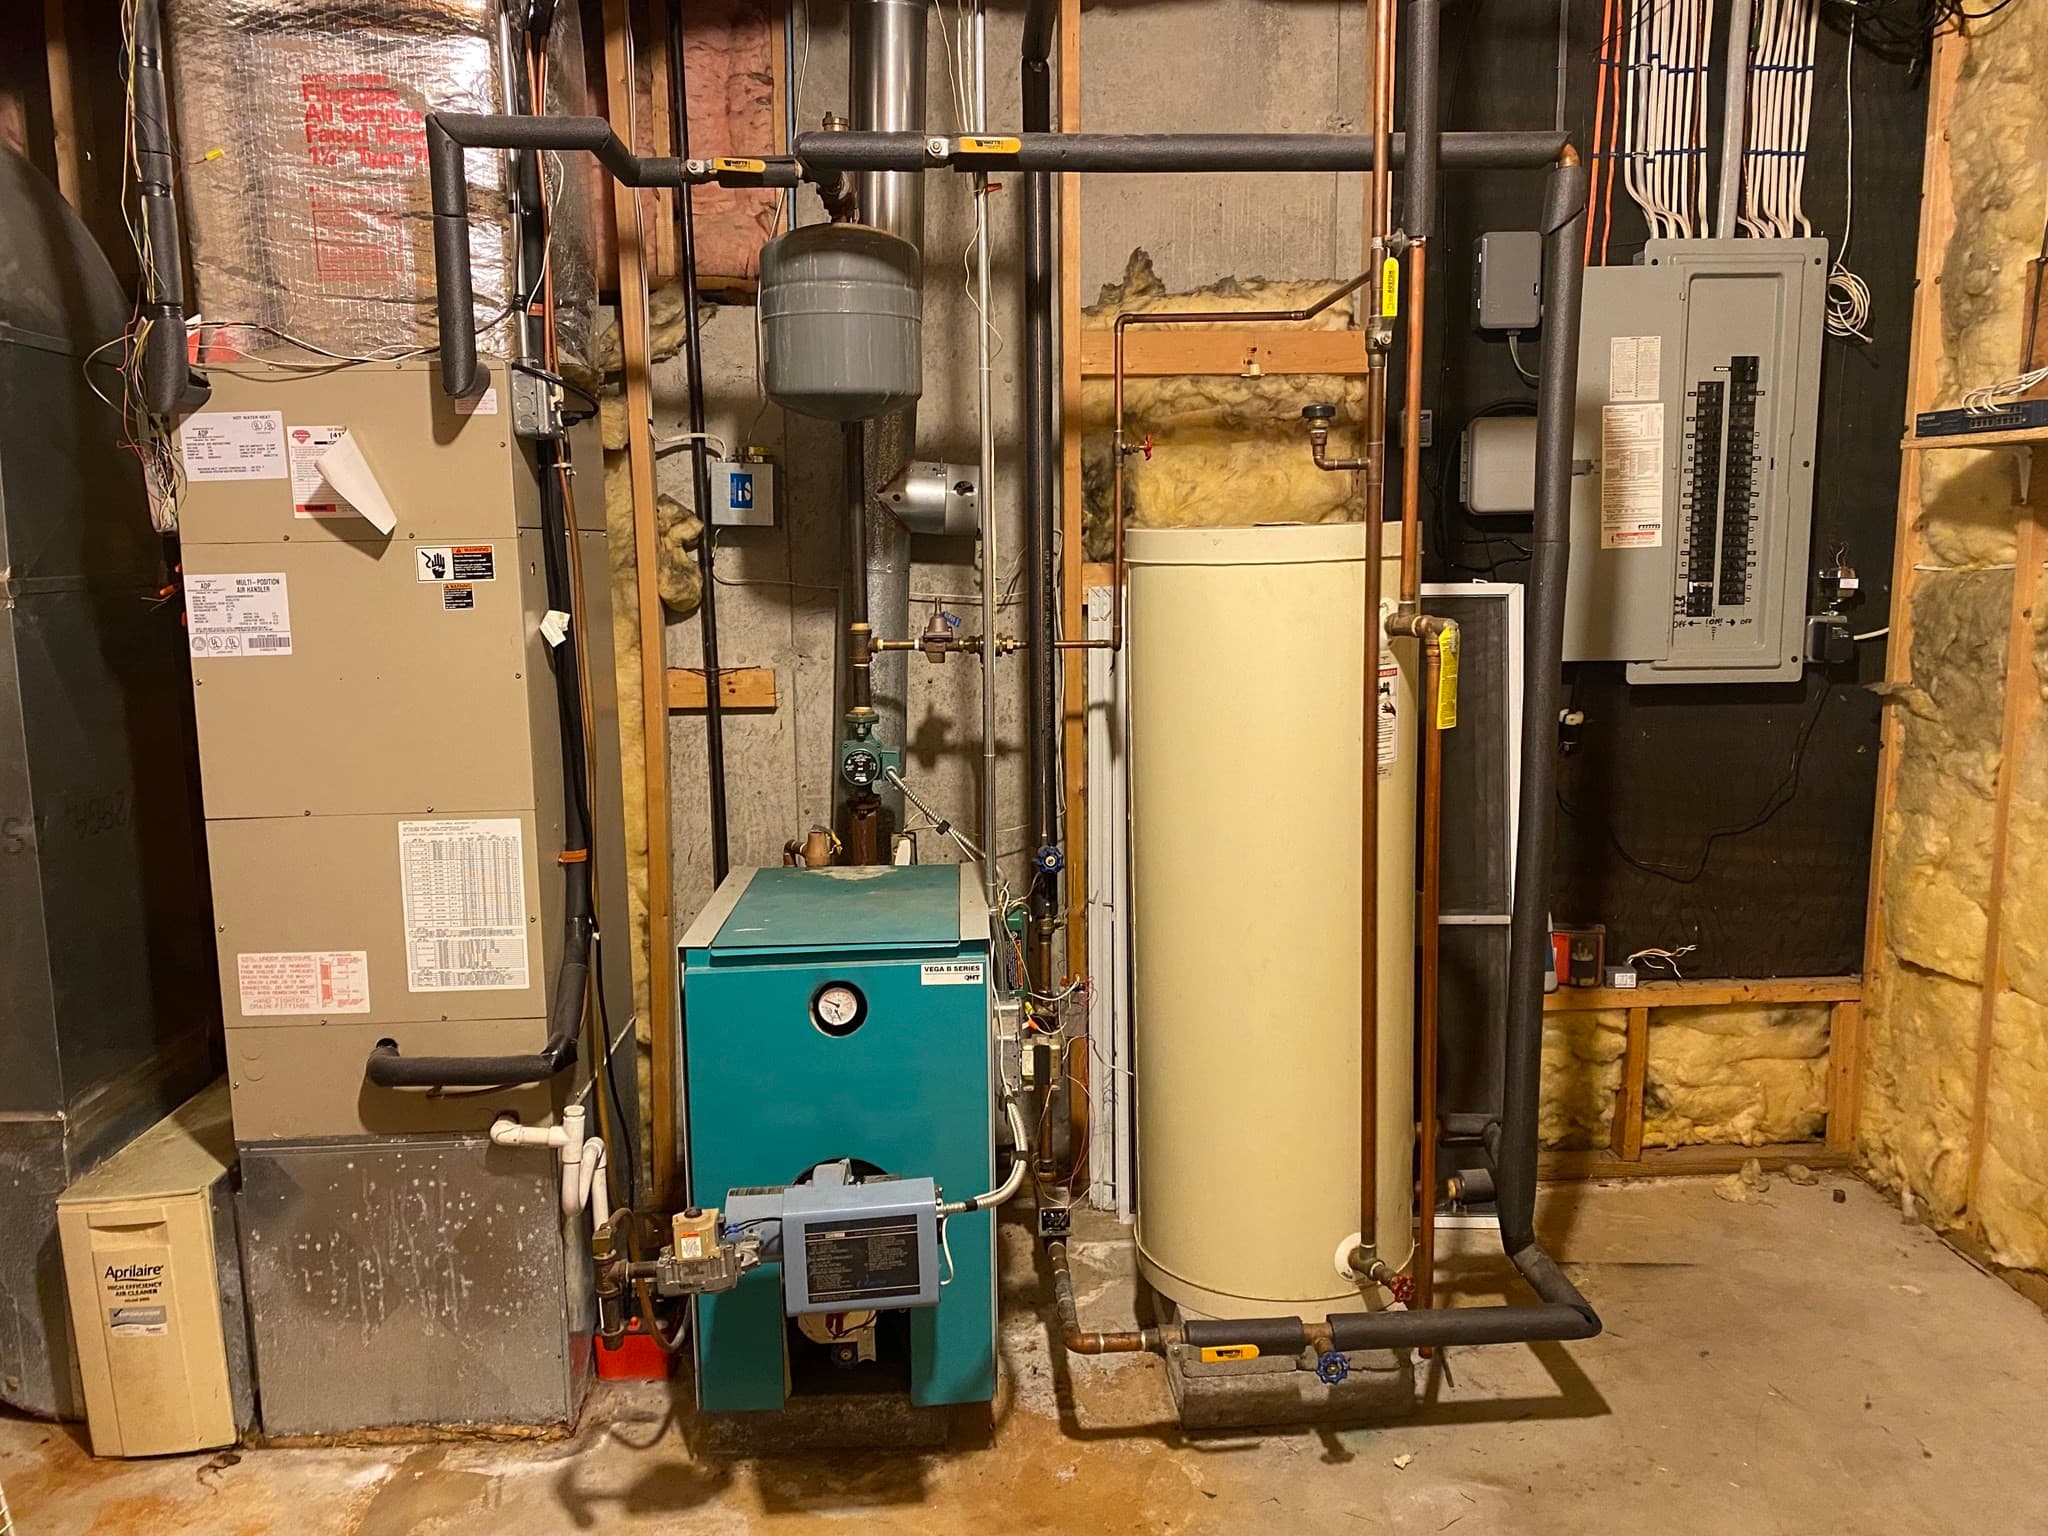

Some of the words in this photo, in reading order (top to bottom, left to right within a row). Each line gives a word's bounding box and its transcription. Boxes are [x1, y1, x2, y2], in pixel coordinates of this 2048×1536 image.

[304, 103, 333, 122] All
[305, 123, 369, 143] Faced
[104, 1264, 164, 1282] Aprilaire
[125, 1281, 162, 1290] EFFICIENCY
[127, 1288, 158, 1297] CLEANER
